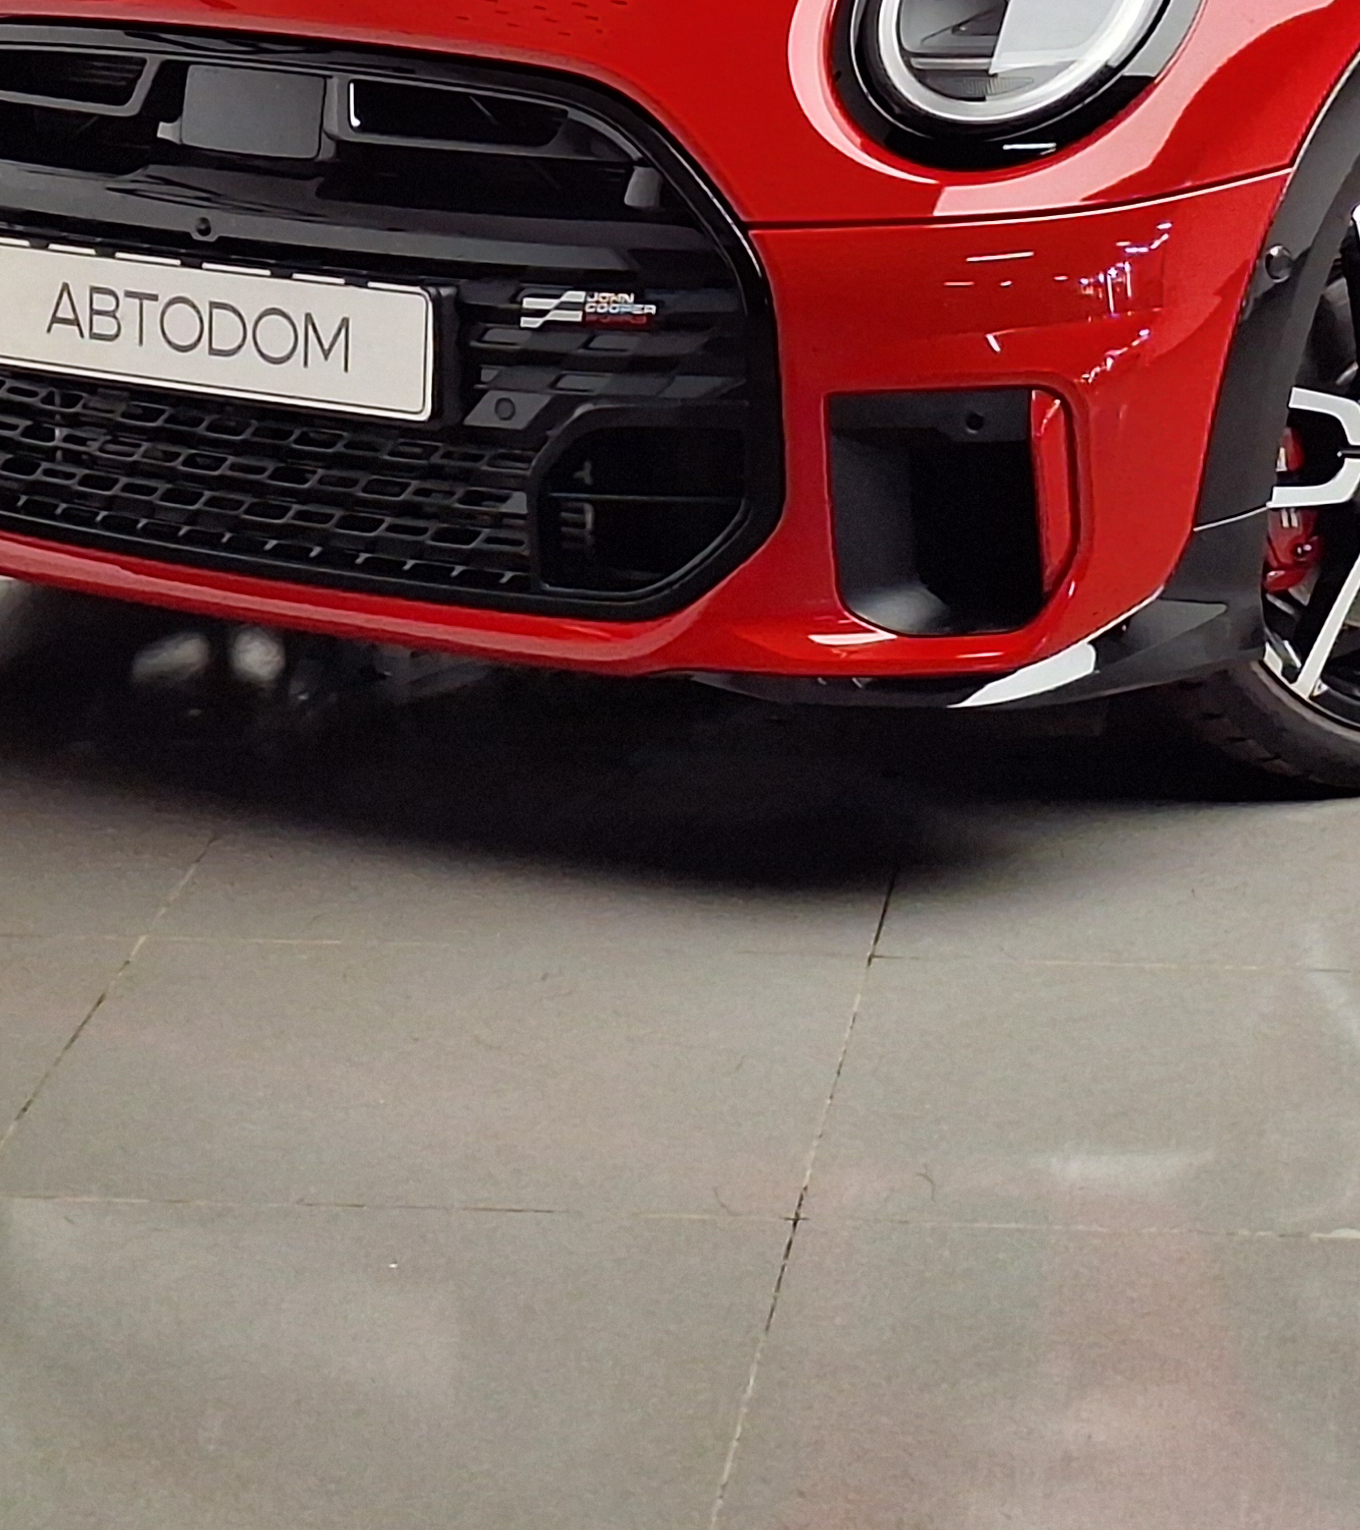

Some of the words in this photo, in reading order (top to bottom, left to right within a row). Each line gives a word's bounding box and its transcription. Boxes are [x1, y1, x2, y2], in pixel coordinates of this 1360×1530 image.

[586, 291, 635, 304] JOHN
[585, 303, 657, 315] COOPER
[46, 282, 351, 373] ABTODOM
